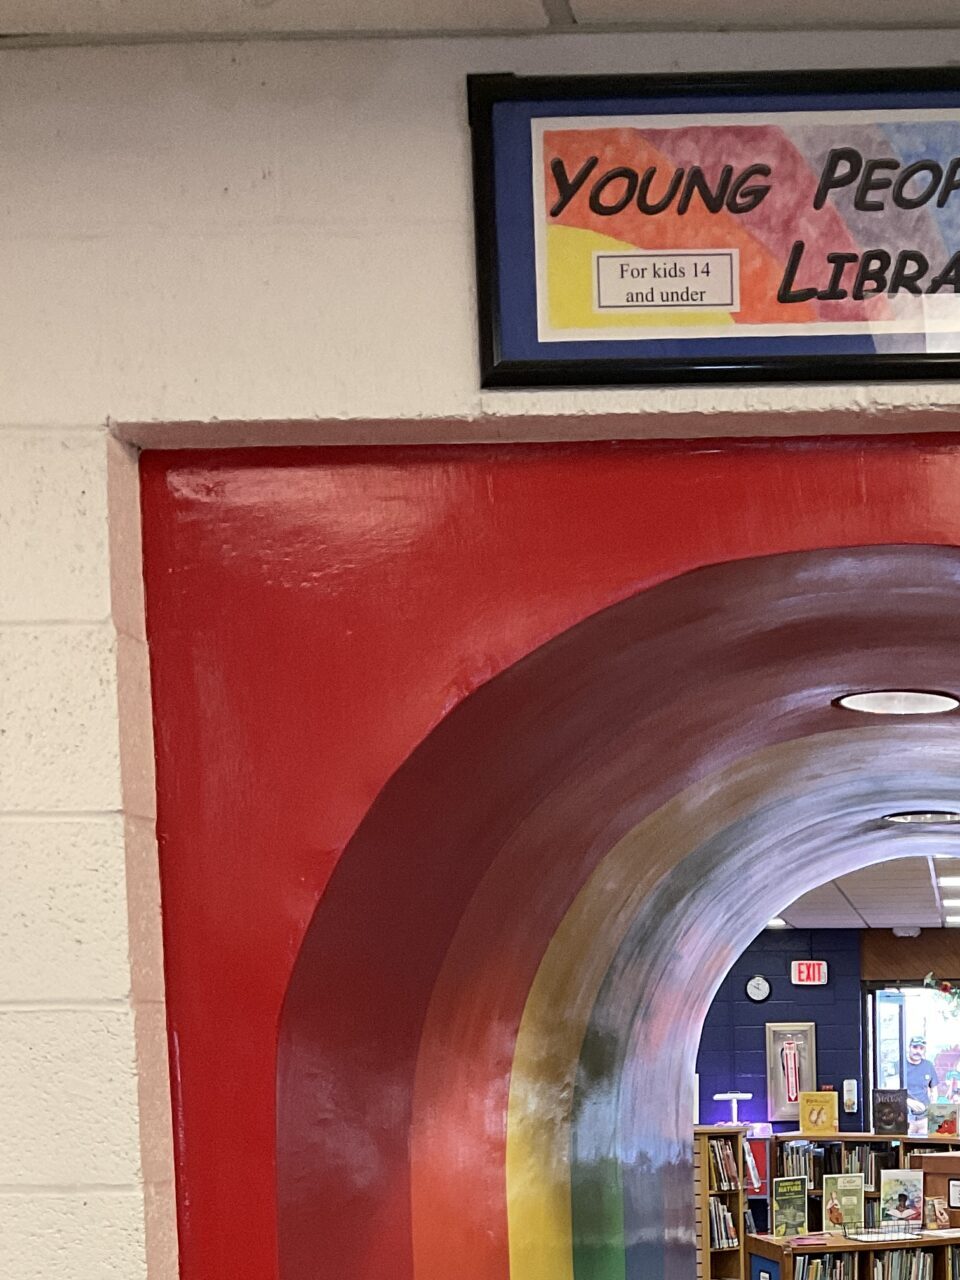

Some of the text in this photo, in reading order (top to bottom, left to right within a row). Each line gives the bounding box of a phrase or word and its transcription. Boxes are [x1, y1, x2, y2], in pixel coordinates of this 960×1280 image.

[549, 155, 773, 218] YOUNG
[619, 262, 711, 279] For kids 14
[626, 286, 706, 303] and under
[797, 962, 824, 983] EXIT
